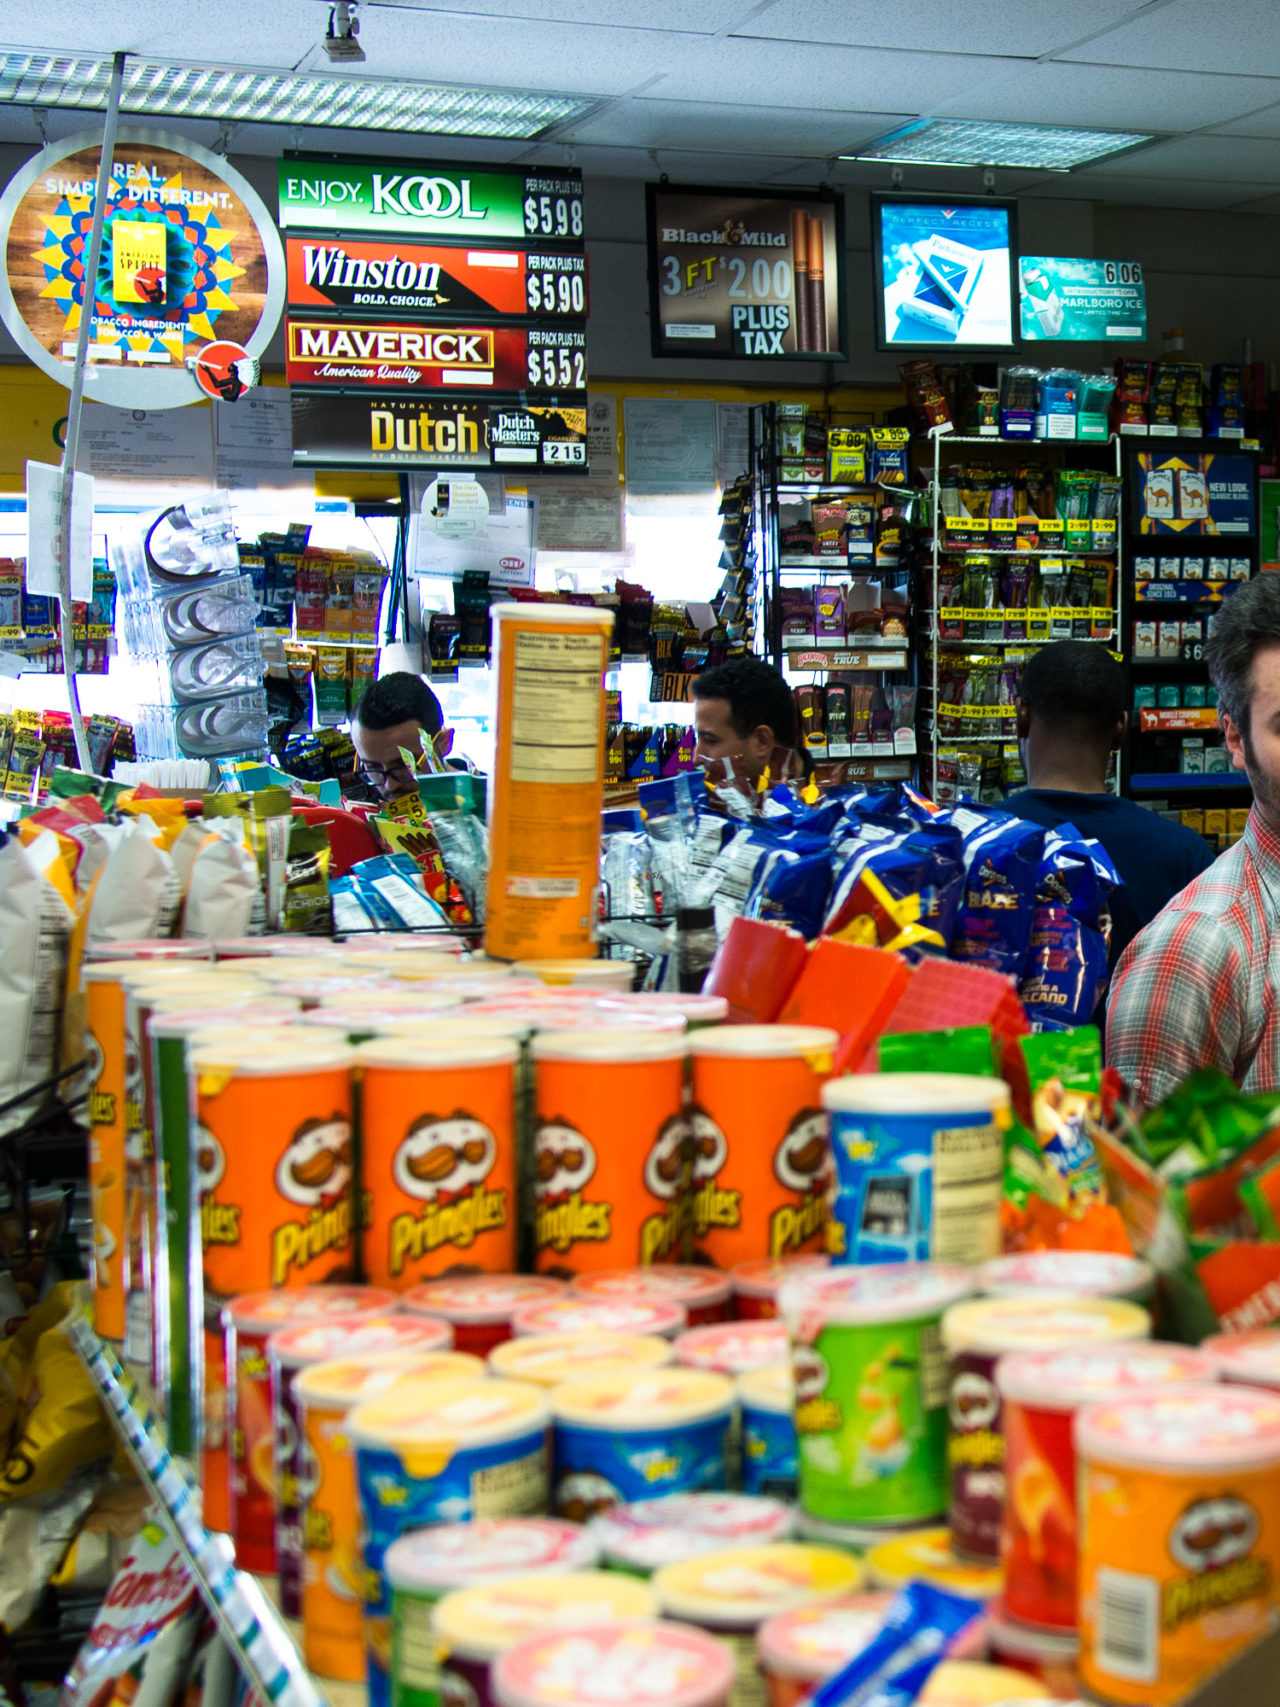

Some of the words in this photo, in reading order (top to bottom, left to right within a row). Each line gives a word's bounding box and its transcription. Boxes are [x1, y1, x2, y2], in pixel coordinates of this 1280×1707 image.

[113, 162, 167, 182] REAL.
[45, 178, 121, 200] SIMPE.
[128, 184, 233, 208] DIFFERENT.
[286, 177, 364, 206] ENJOY.
[370, 173, 489, 219] KOOL
[525, 179, 539, 192] PER
[539, 180, 554, 193] PACK
[555, 181, 570, 194] PLUS
[570, 181, 584, 194] TAX
[662, 228, 725, 245] Black
[740, 231, 787, 247] Mild
[120, 259, 160, 270] SPIRIT
[302, 245, 441, 291] Winston
[528, 255, 541, 269] PER
[541, 257, 556, 270] PACK
[556, 257, 571, 271] PLUS
[571, 258, 585, 271] TAX
[662, 255, 682, 296] 3
[352, 293, 388, 305] BOLD.
[388, 294, 437, 308] CHOICE.
[1060, 296, 1123, 309] MARLBORO
[1125, 300, 1143, 309] ICE
[90, 316, 129, 328] OBACCO
[732, 305, 790, 330] PLUS
[299, 327, 485, 363] MAVERICK
[528, 331, 541, 344] PER
[541, 331, 557, 345] PACK
[557, 332, 572, 346] PLUS
[572, 333, 586, 347] TAX
[740, 331, 785, 355] TAX
[313, 362, 376, 380] American
[376, 364, 422, 384] Quality
[370, 402, 434, 410] NATURAL
[443, 403, 478, 411] LEAF
[498, 413, 536, 431] Dutch
[370, 411, 478, 453] Dutch
[491, 427, 540, 443] Masters
[1209, 482, 1226, 493] NEW
[833, 656, 860, 665] TRUE
[663, 673, 692, 702] BLK
[847, 767, 866, 776] RUE
[967, 890, 1020, 910] BLAZE
[389, 1183, 507, 1278] Pringles
